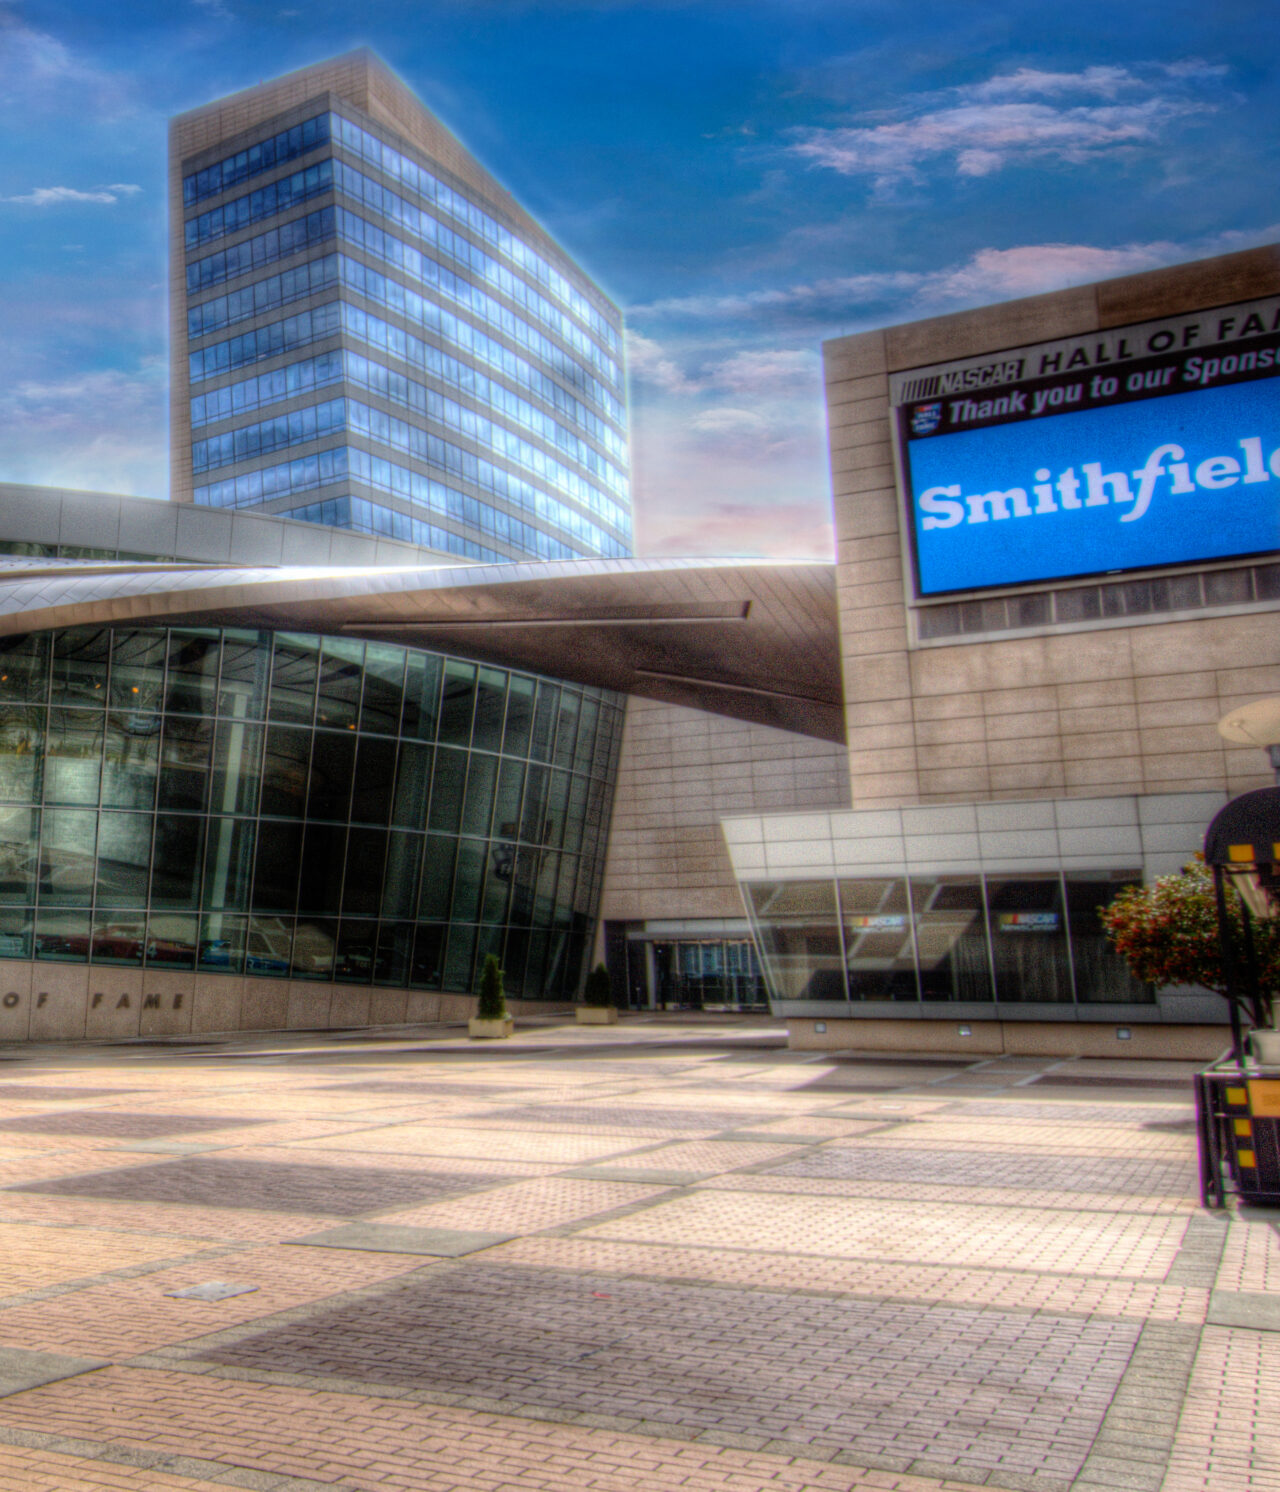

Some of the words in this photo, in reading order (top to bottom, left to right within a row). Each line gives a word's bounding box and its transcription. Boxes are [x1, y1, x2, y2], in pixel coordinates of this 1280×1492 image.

[937, 360, 1020, 395] NASCAR
[1039, 339, 1132, 375] HALL
[1148, 325, 1200, 352] OF
[949, 391, 1028, 424] Thank
[1030, 383, 1083, 415] you
[1089, 374, 1119, 398] to
[1125, 366, 1176, 392] our
[919, 436, 1280, 531] Smithfiel
[2, 991, 49, 1009] OF
[91, 992, 184, 1010] FAME
